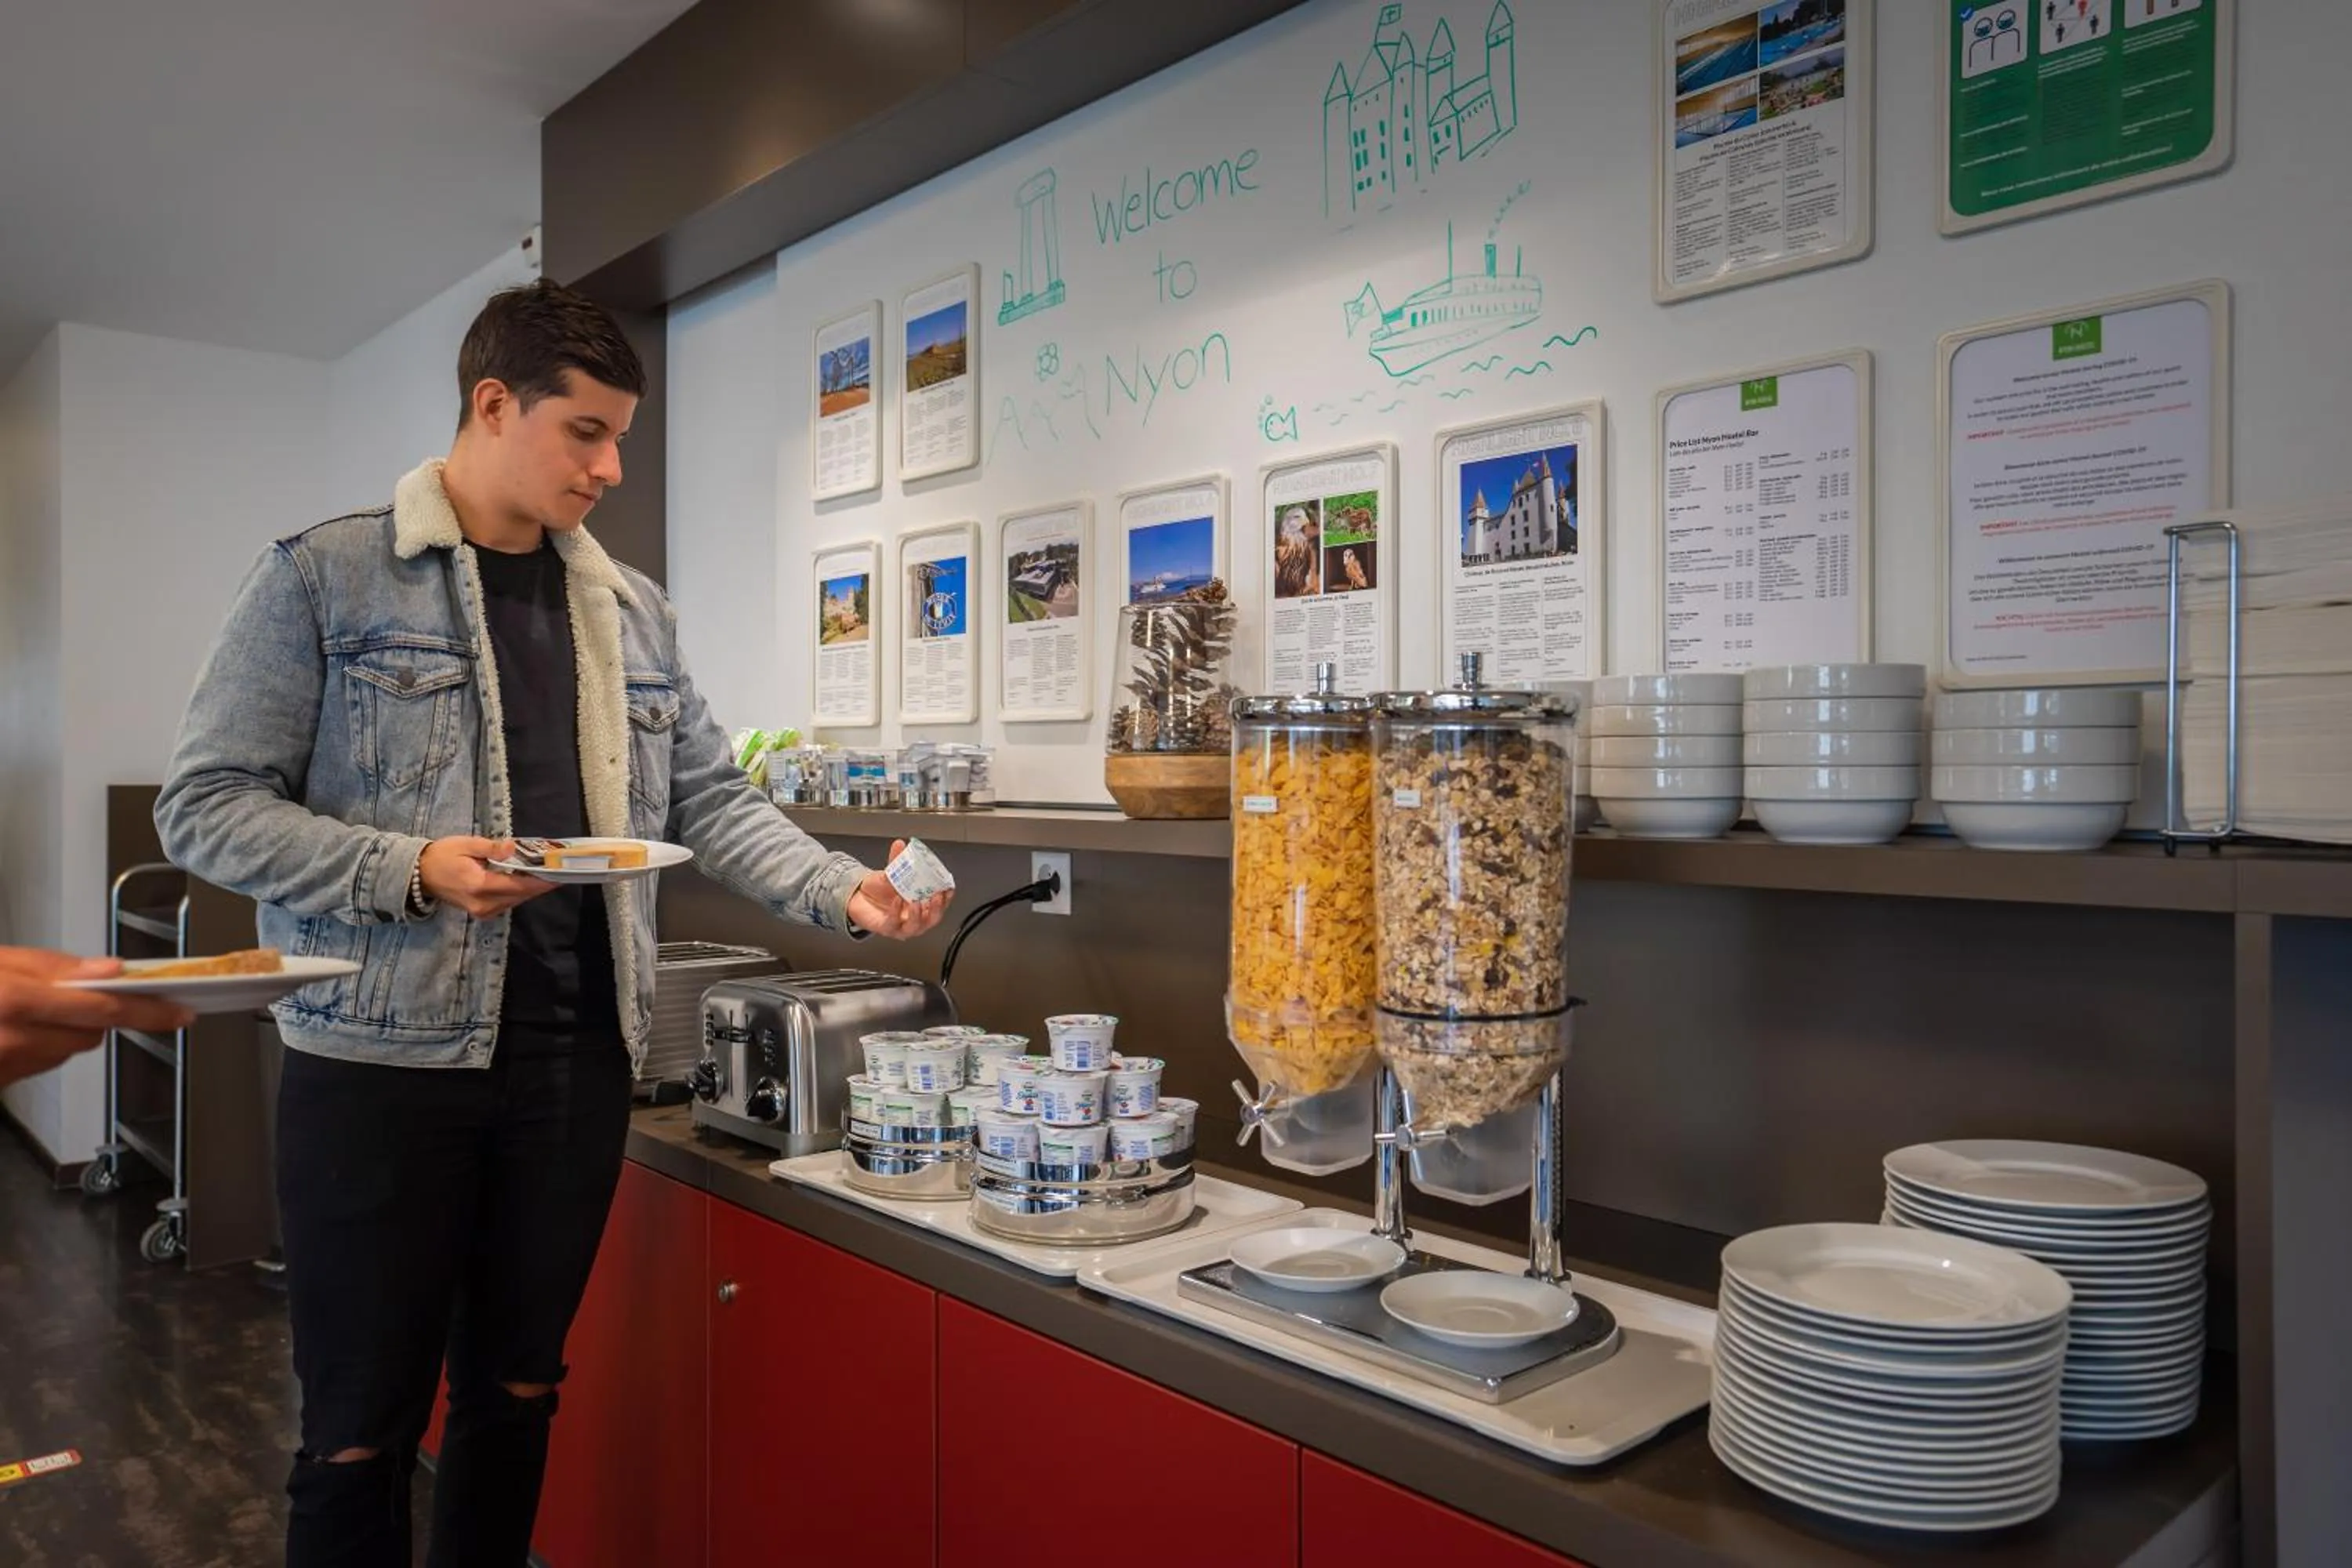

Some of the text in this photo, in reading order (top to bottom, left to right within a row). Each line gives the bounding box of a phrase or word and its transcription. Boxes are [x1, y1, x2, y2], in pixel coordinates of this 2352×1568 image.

[1092, 149, 1260, 245] Welcome
[1152, 249, 1198, 303] to
[1105, 332, 1231, 429] Nyon
[1669, 440, 1687, 450] Price
